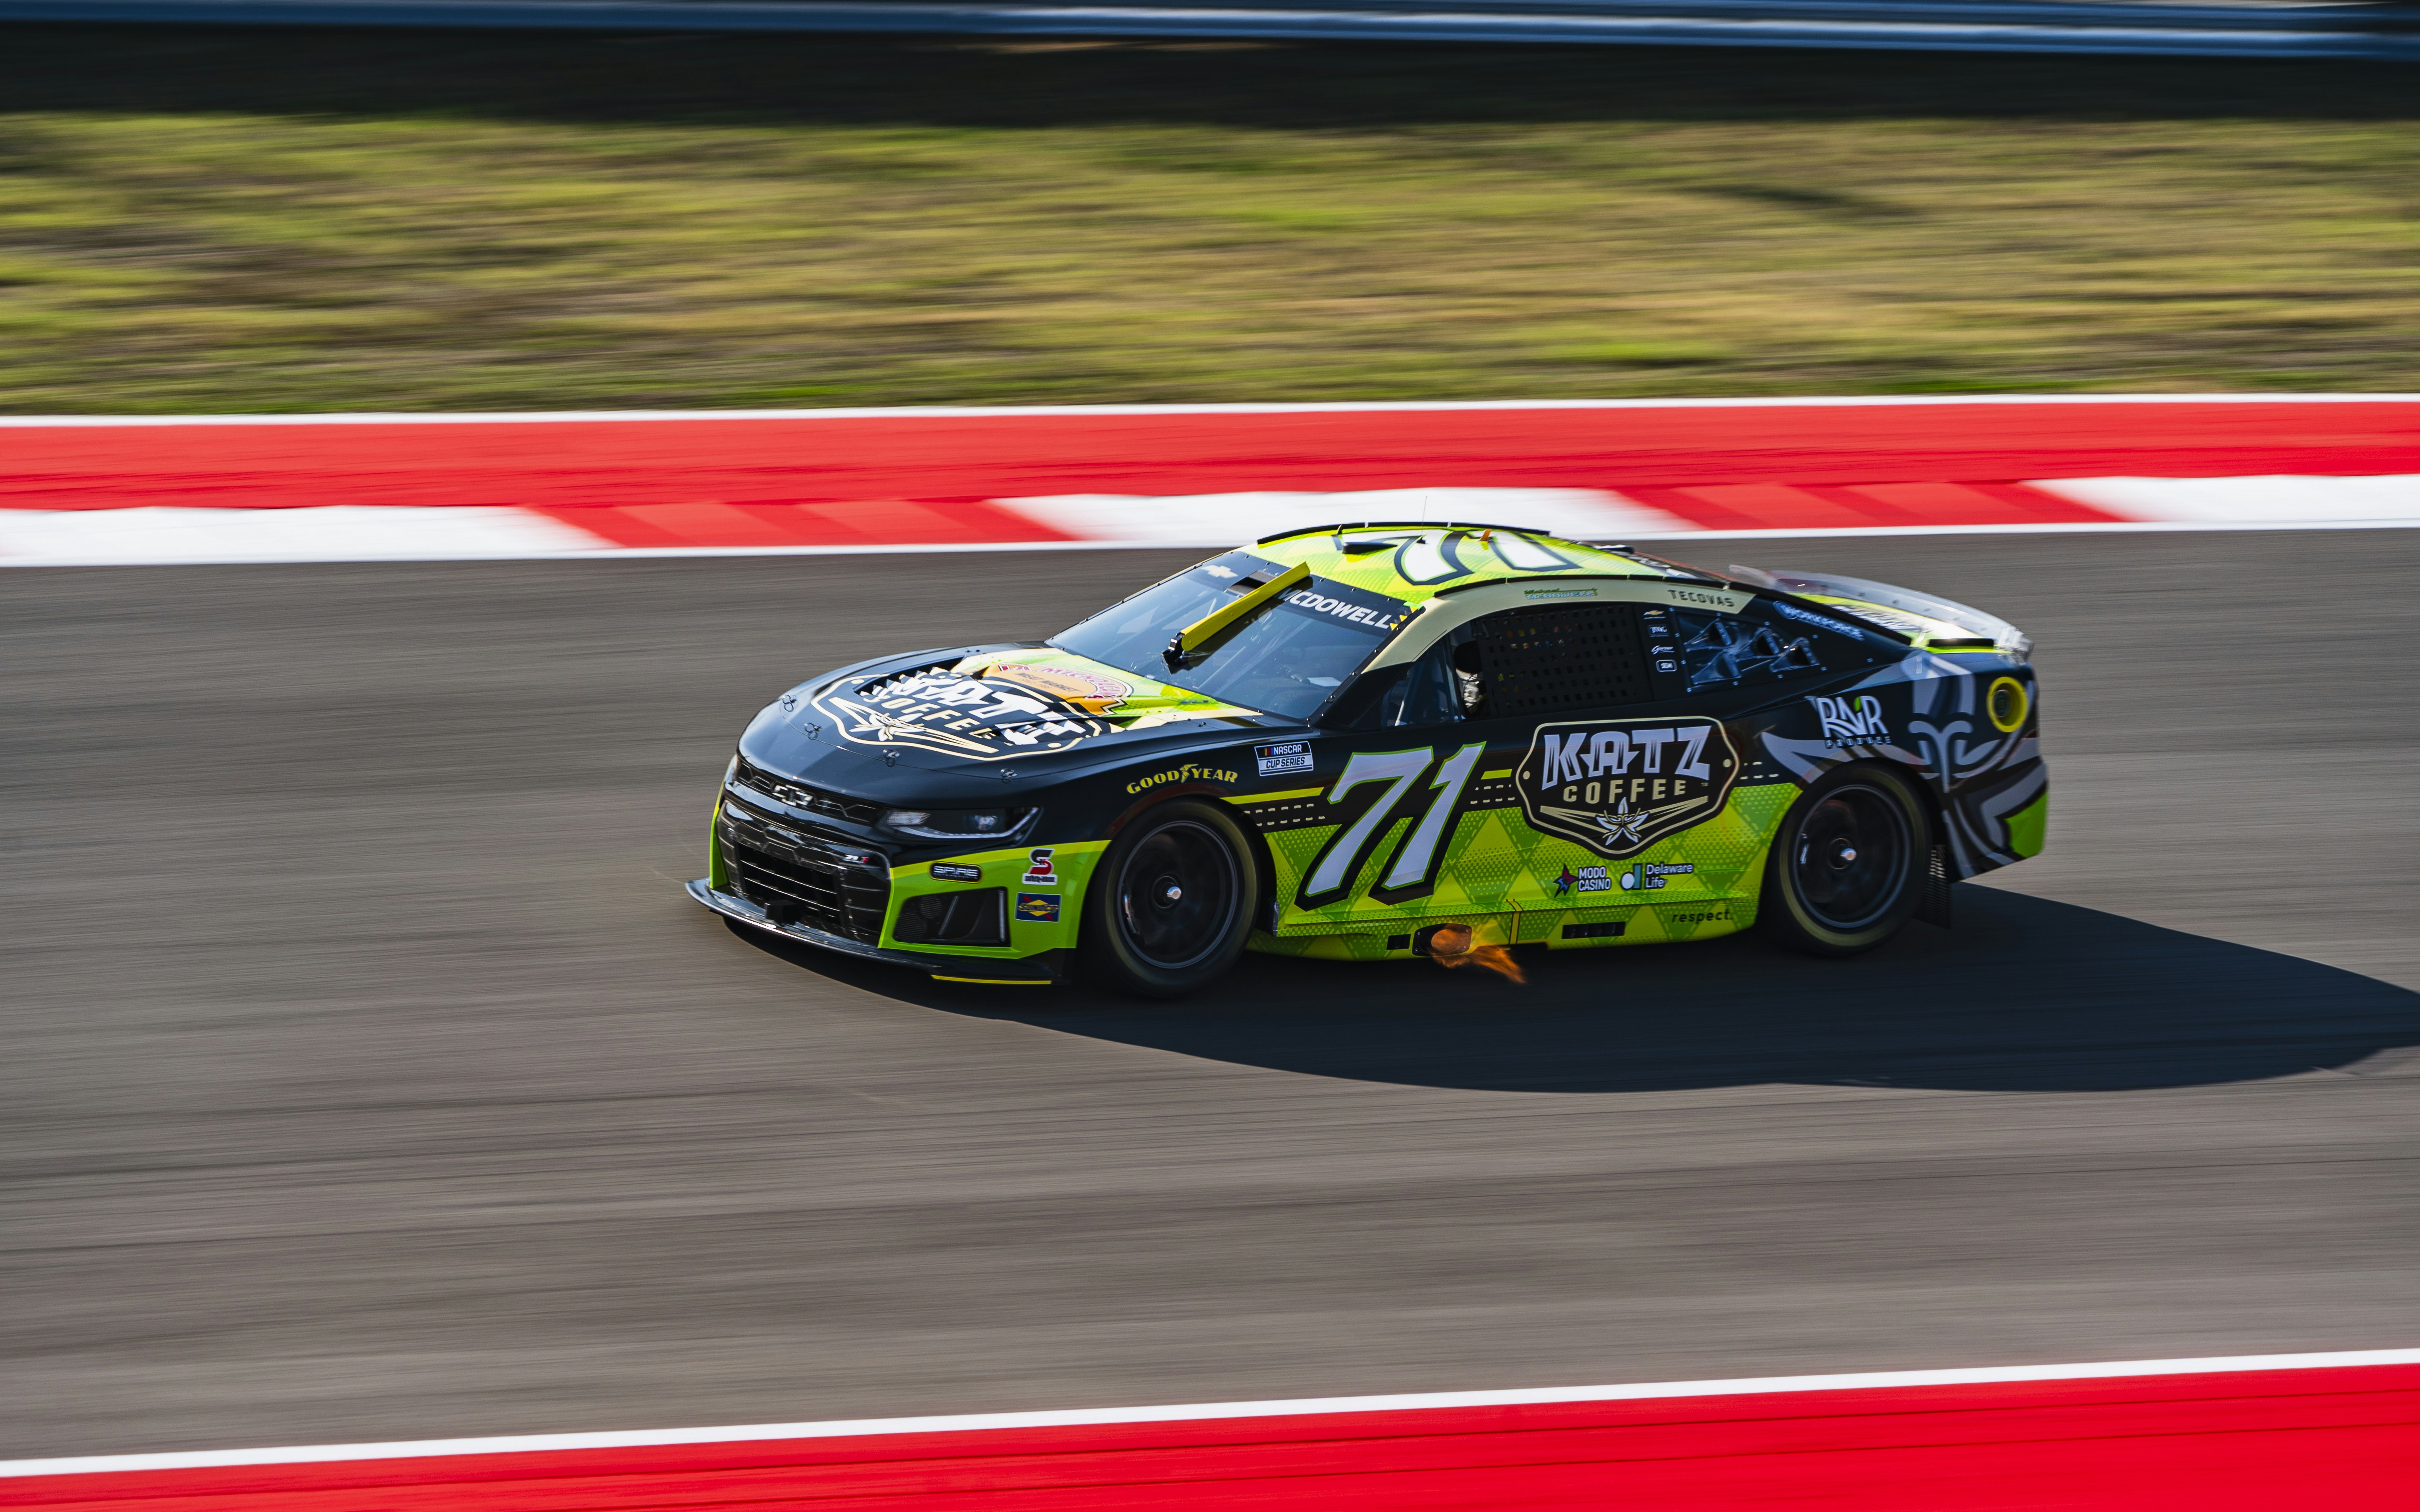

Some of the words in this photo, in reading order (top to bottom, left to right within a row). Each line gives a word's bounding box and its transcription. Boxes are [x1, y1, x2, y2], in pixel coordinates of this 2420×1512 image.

[1667, 589, 1735, 607] TECOVAS
[1825, 736, 1892, 748] PRODUCE
[1273, 744, 1302, 755] NASCAR
[1266, 758, 1281, 768] CUP
[1281, 756, 1305, 767] SERIES
[1542, 725, 1712, 790] KATZ
[1127, 764, 1238, 794] GOODYEAR
[1563, 779, 1686, 804] COFFEE
[1304, 741, 1487, 896] 71
[934, 866, 978, 877] SPIRE
[1579, 866, 1606, 879] MODO
[1646, 863, 1694, 875] Delaware
[1578, 878, 1611, 891] CASINO
